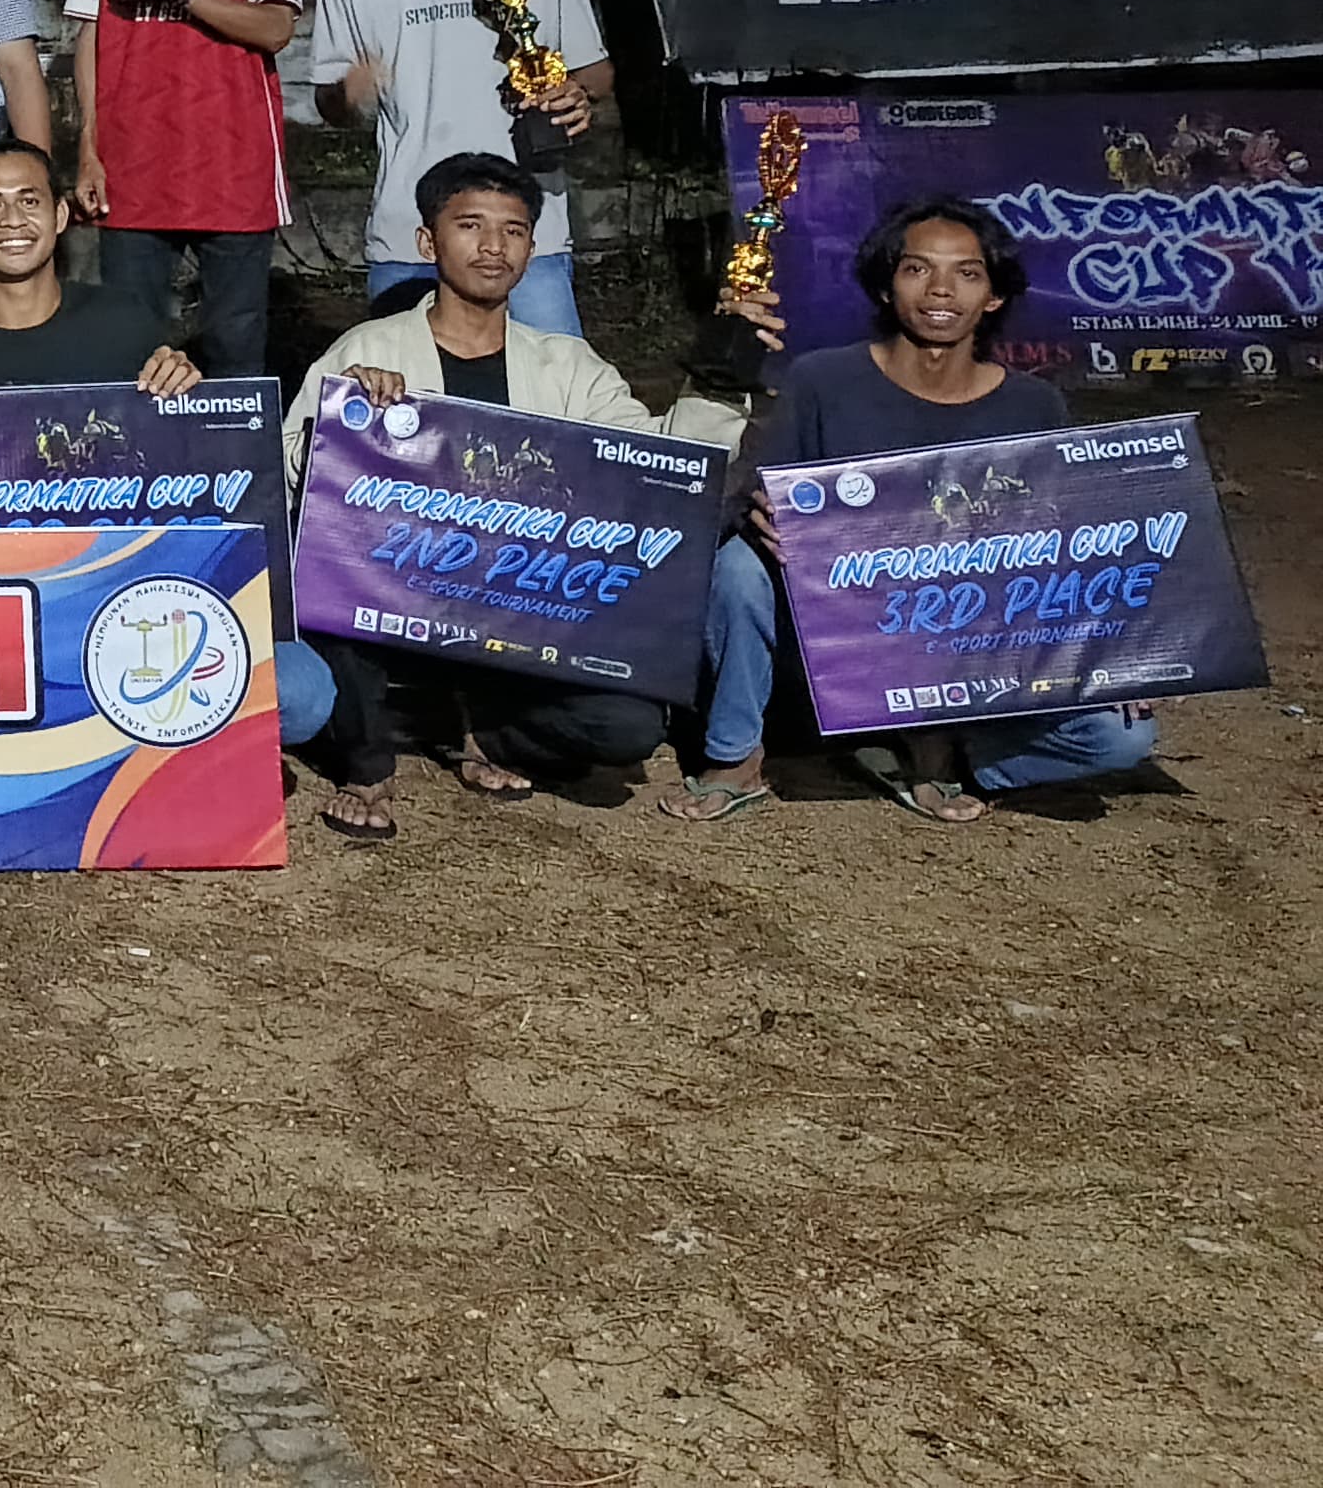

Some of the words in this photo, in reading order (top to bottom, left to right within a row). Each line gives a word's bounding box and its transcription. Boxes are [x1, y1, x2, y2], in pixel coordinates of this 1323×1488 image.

[1068, 237, 1234, 312] CUP
[1235, 315, 1288, 329] APRIL
[1174, 348, 1228, 361] REZKY
[151, 392, 263, 416] Telkomsel
[593, 437, 709, 478] Telkomsel
[1056, 428, 1186, 465] Telkomsel
[147, 473, 208, 508] CUP
[212, 469, 254, 513] VI
[345, 474, 567, 543] INFORMATIKA
[566, 517, 634, 553] CUP
[637, 525, 682, 570] VI
[370, 520, 479, 574] 2ND
[484, 544, 641, 605] PLACE
[828, 528, 1062, 590] INFORMATIKA
[1068, 520, 1139, 561] CUP
[1144, 511, 1188, 559] VI
[95, 596, 130, 649] HIMPUNAN
[136, 584, 200, 600] MAHASISWA
[480, 588, 595, 625] TOURNAMENT
[876, 580, 987, 635] 3RD
[1003, 561, 1163, 626] PLACE
[109, 701, 148, 732] TEKNIK
[156, 692, 234, 738] INFORMATIKA
